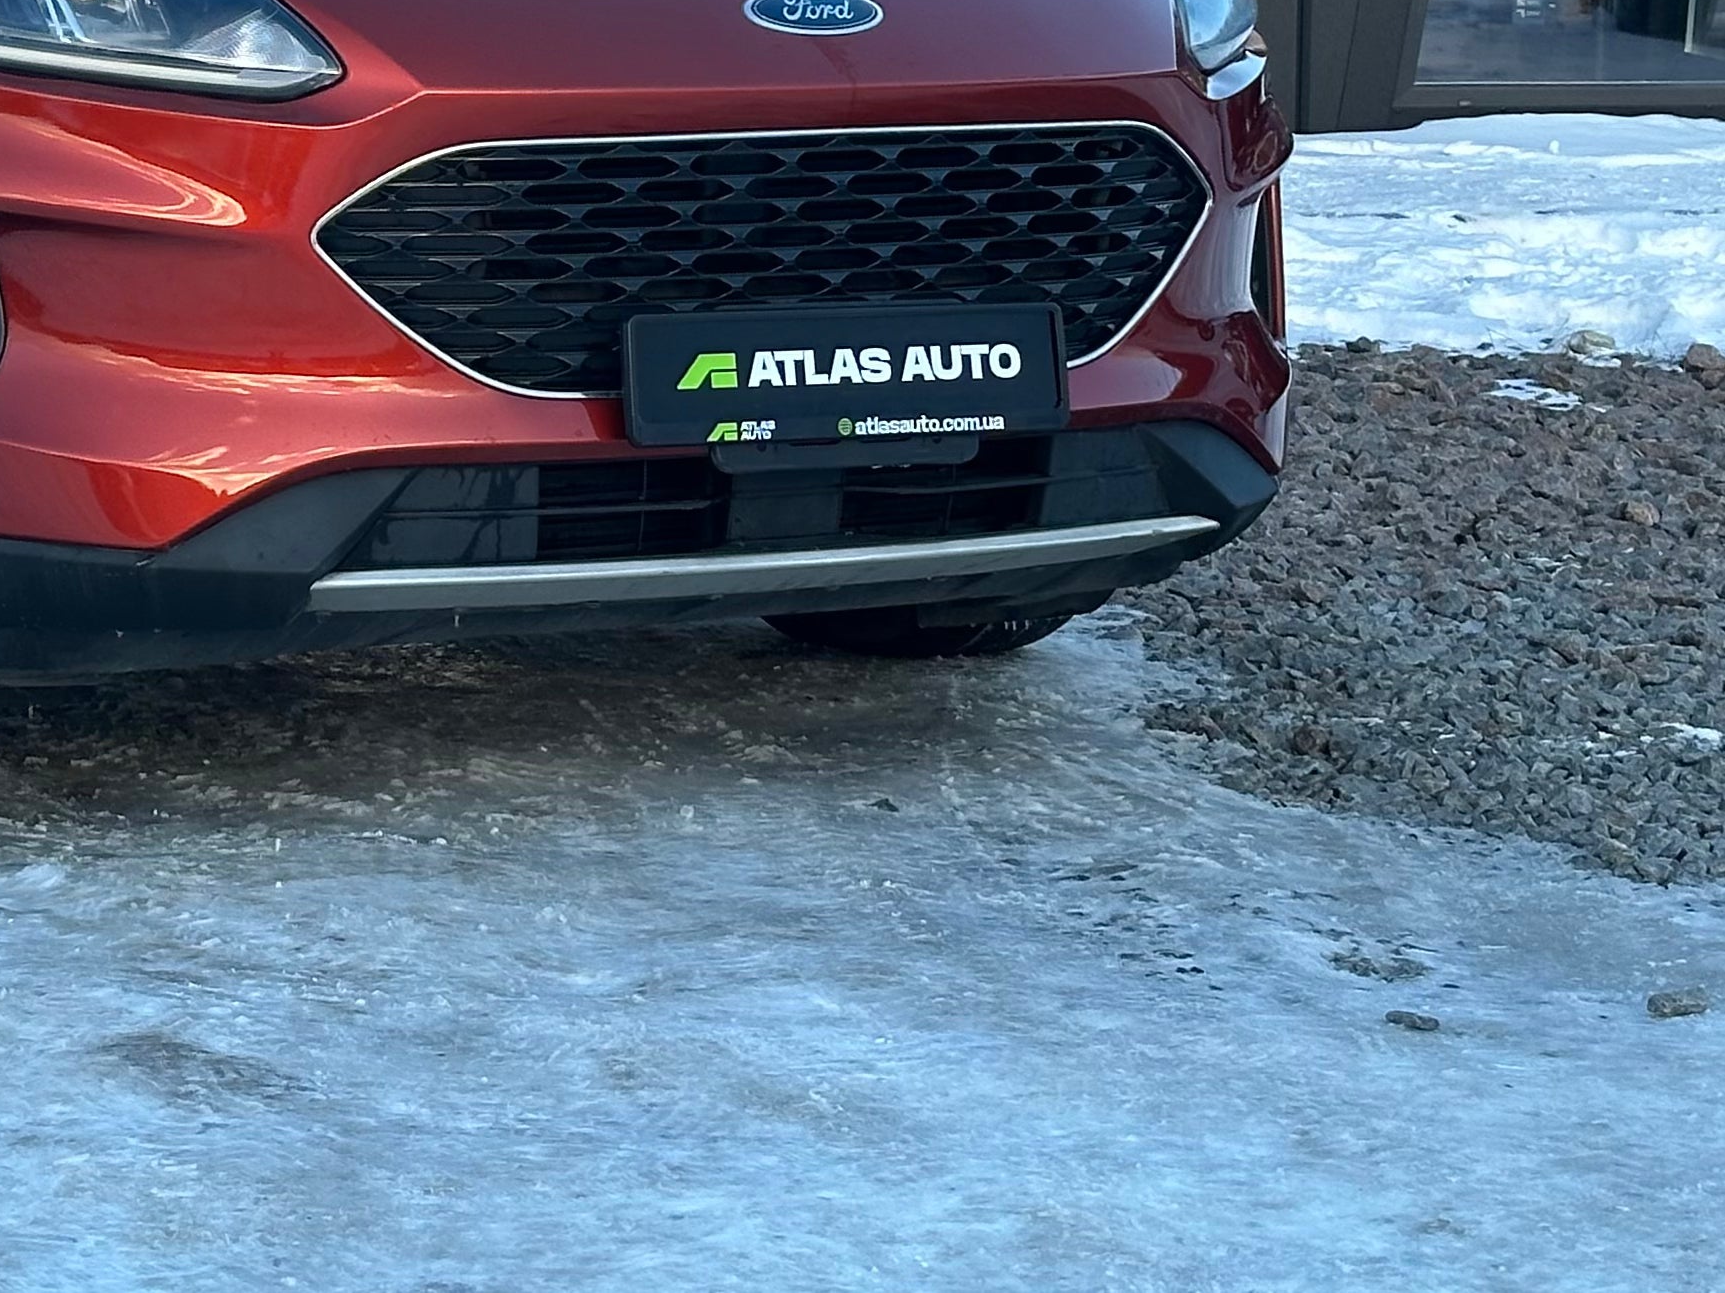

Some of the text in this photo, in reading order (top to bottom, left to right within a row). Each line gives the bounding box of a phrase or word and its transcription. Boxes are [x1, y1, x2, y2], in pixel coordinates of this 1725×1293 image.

[748, 343, 1022, 388] ATLAS AUTO
[740, 420, 776, 431] ATLAS
[855, 415, 1005, 436] atlasauto.com.ua
[740, 430, 772, 441] AUTO
